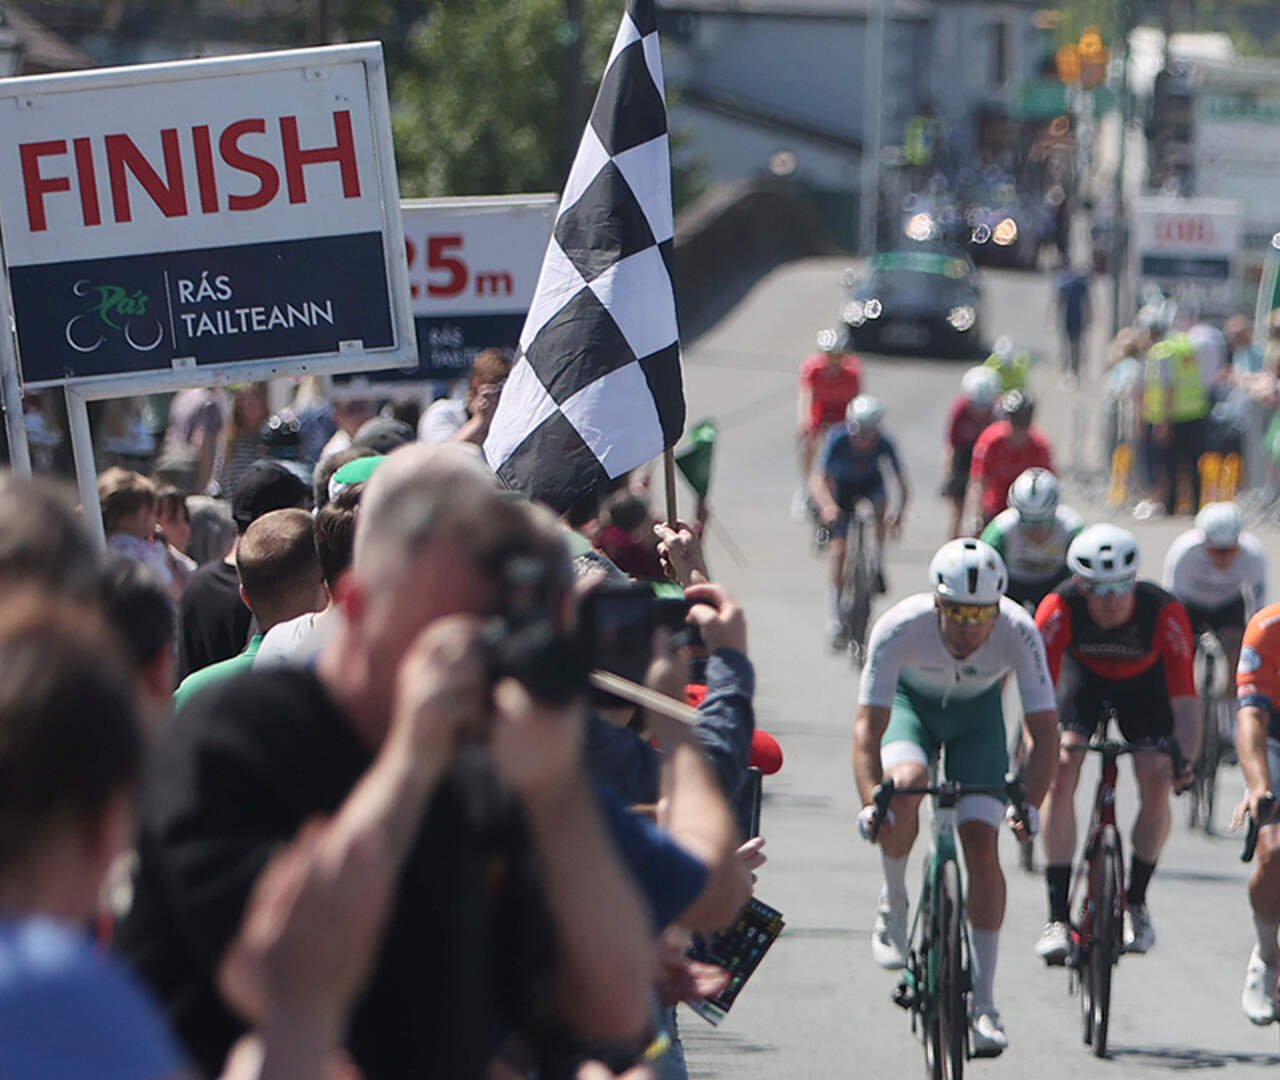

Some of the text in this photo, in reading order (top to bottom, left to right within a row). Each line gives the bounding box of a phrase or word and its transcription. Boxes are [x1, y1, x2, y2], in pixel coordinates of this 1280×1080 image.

[19, 110, 361, 232] FINISH
[178, 271, 232, 303] RÁS
[181, 300, 334, 338] TAILTEANN
